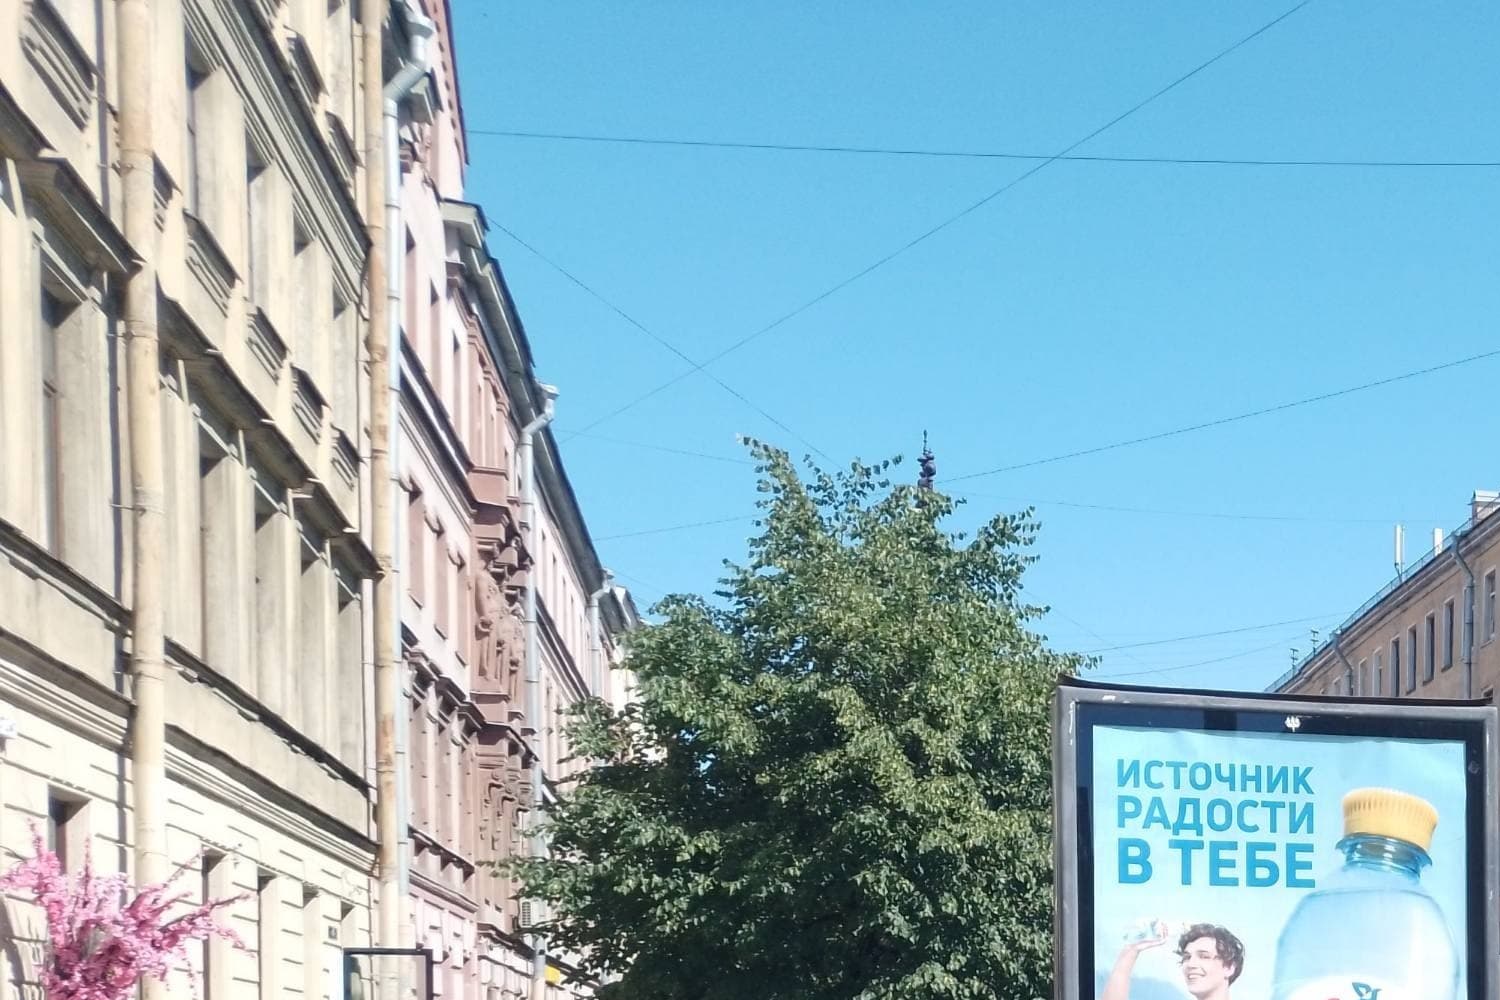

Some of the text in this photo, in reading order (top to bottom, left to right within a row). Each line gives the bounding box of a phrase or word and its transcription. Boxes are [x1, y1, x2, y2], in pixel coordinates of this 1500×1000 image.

[1117, 758, 1315, 795] ИСТОЧНИК
[1117, 795, 1315, 837] РАДОСТИ
[1118, 837, 1316, 889] В ТЕБЕ
